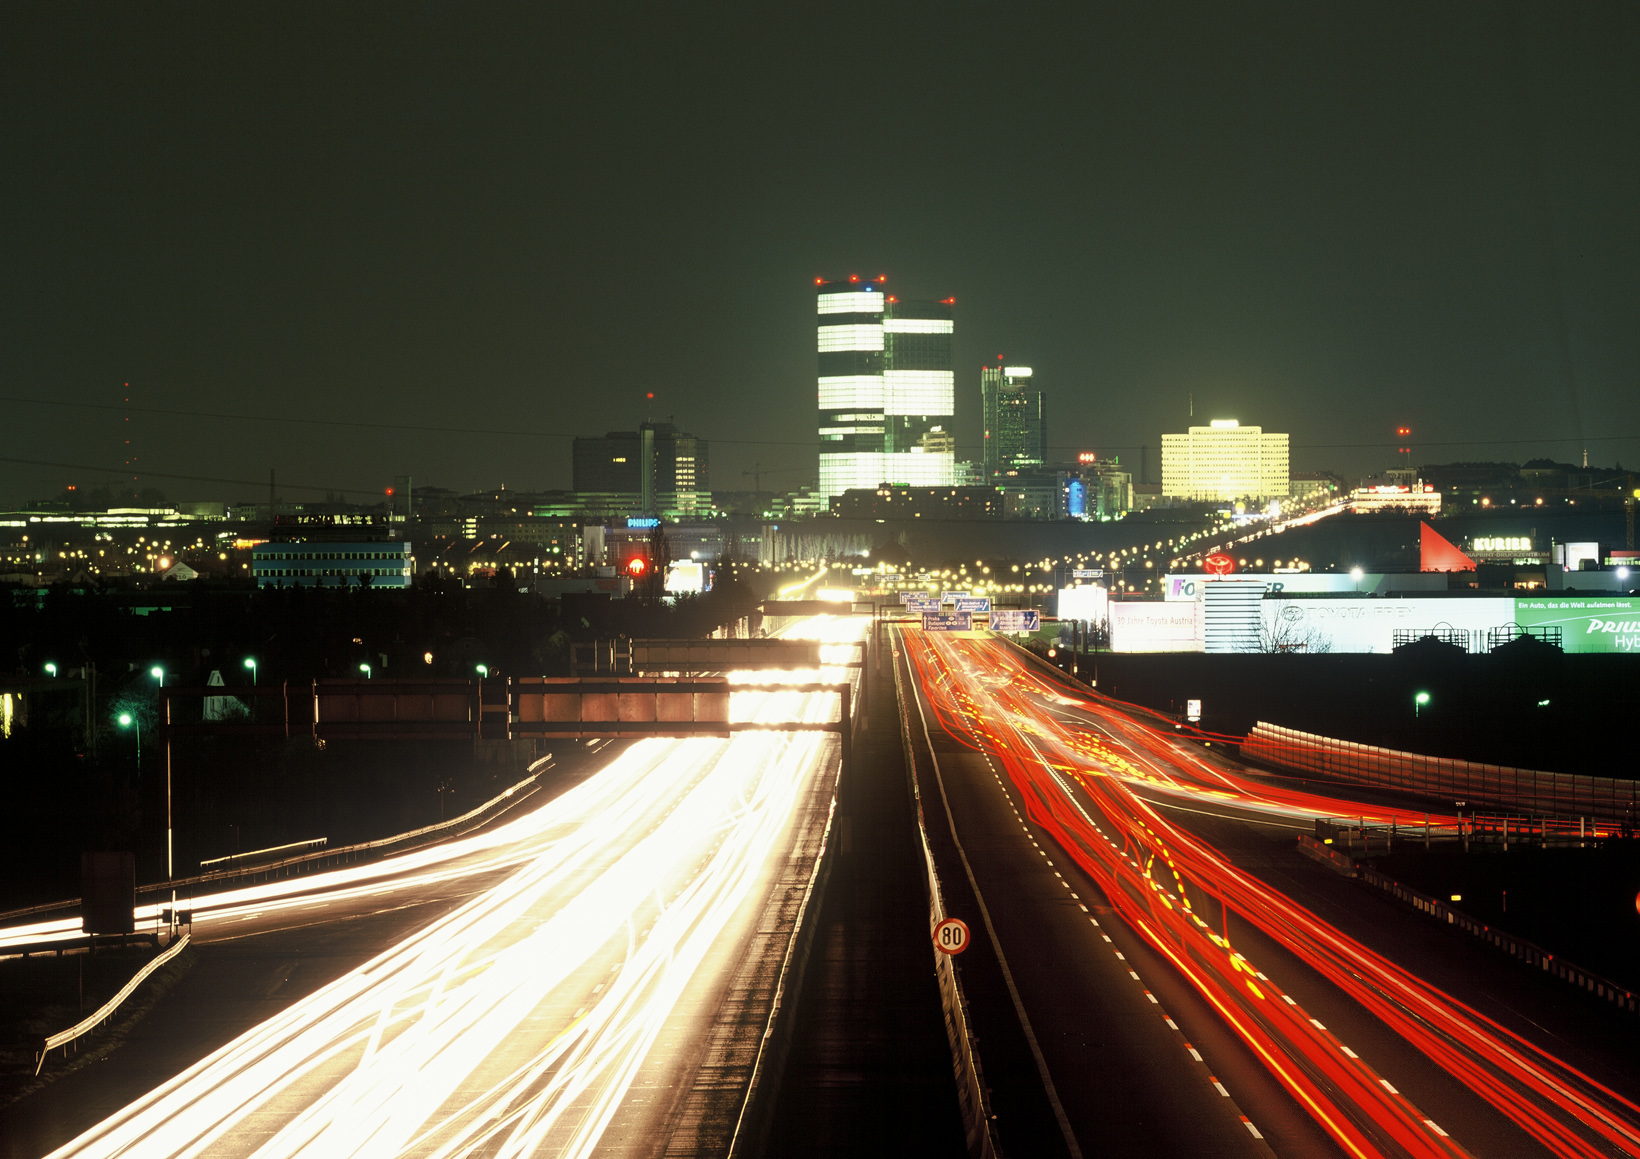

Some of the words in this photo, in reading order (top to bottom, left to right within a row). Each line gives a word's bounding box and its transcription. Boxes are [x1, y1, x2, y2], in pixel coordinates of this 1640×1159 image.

[628, 518, 658, 528] PHILIPS
[1473, 537, 1531, 551] KURIER
[1306, 606, 1366, 618] TOYOTA
[1117, 616, 1125, 625] 30
[1127, 616, 1144, 625] Jahre
[1146, 616, 1168, 627] Toyota
[1170, 616, 1193, 625] Austria
[942, 926, 961, 946] 80
